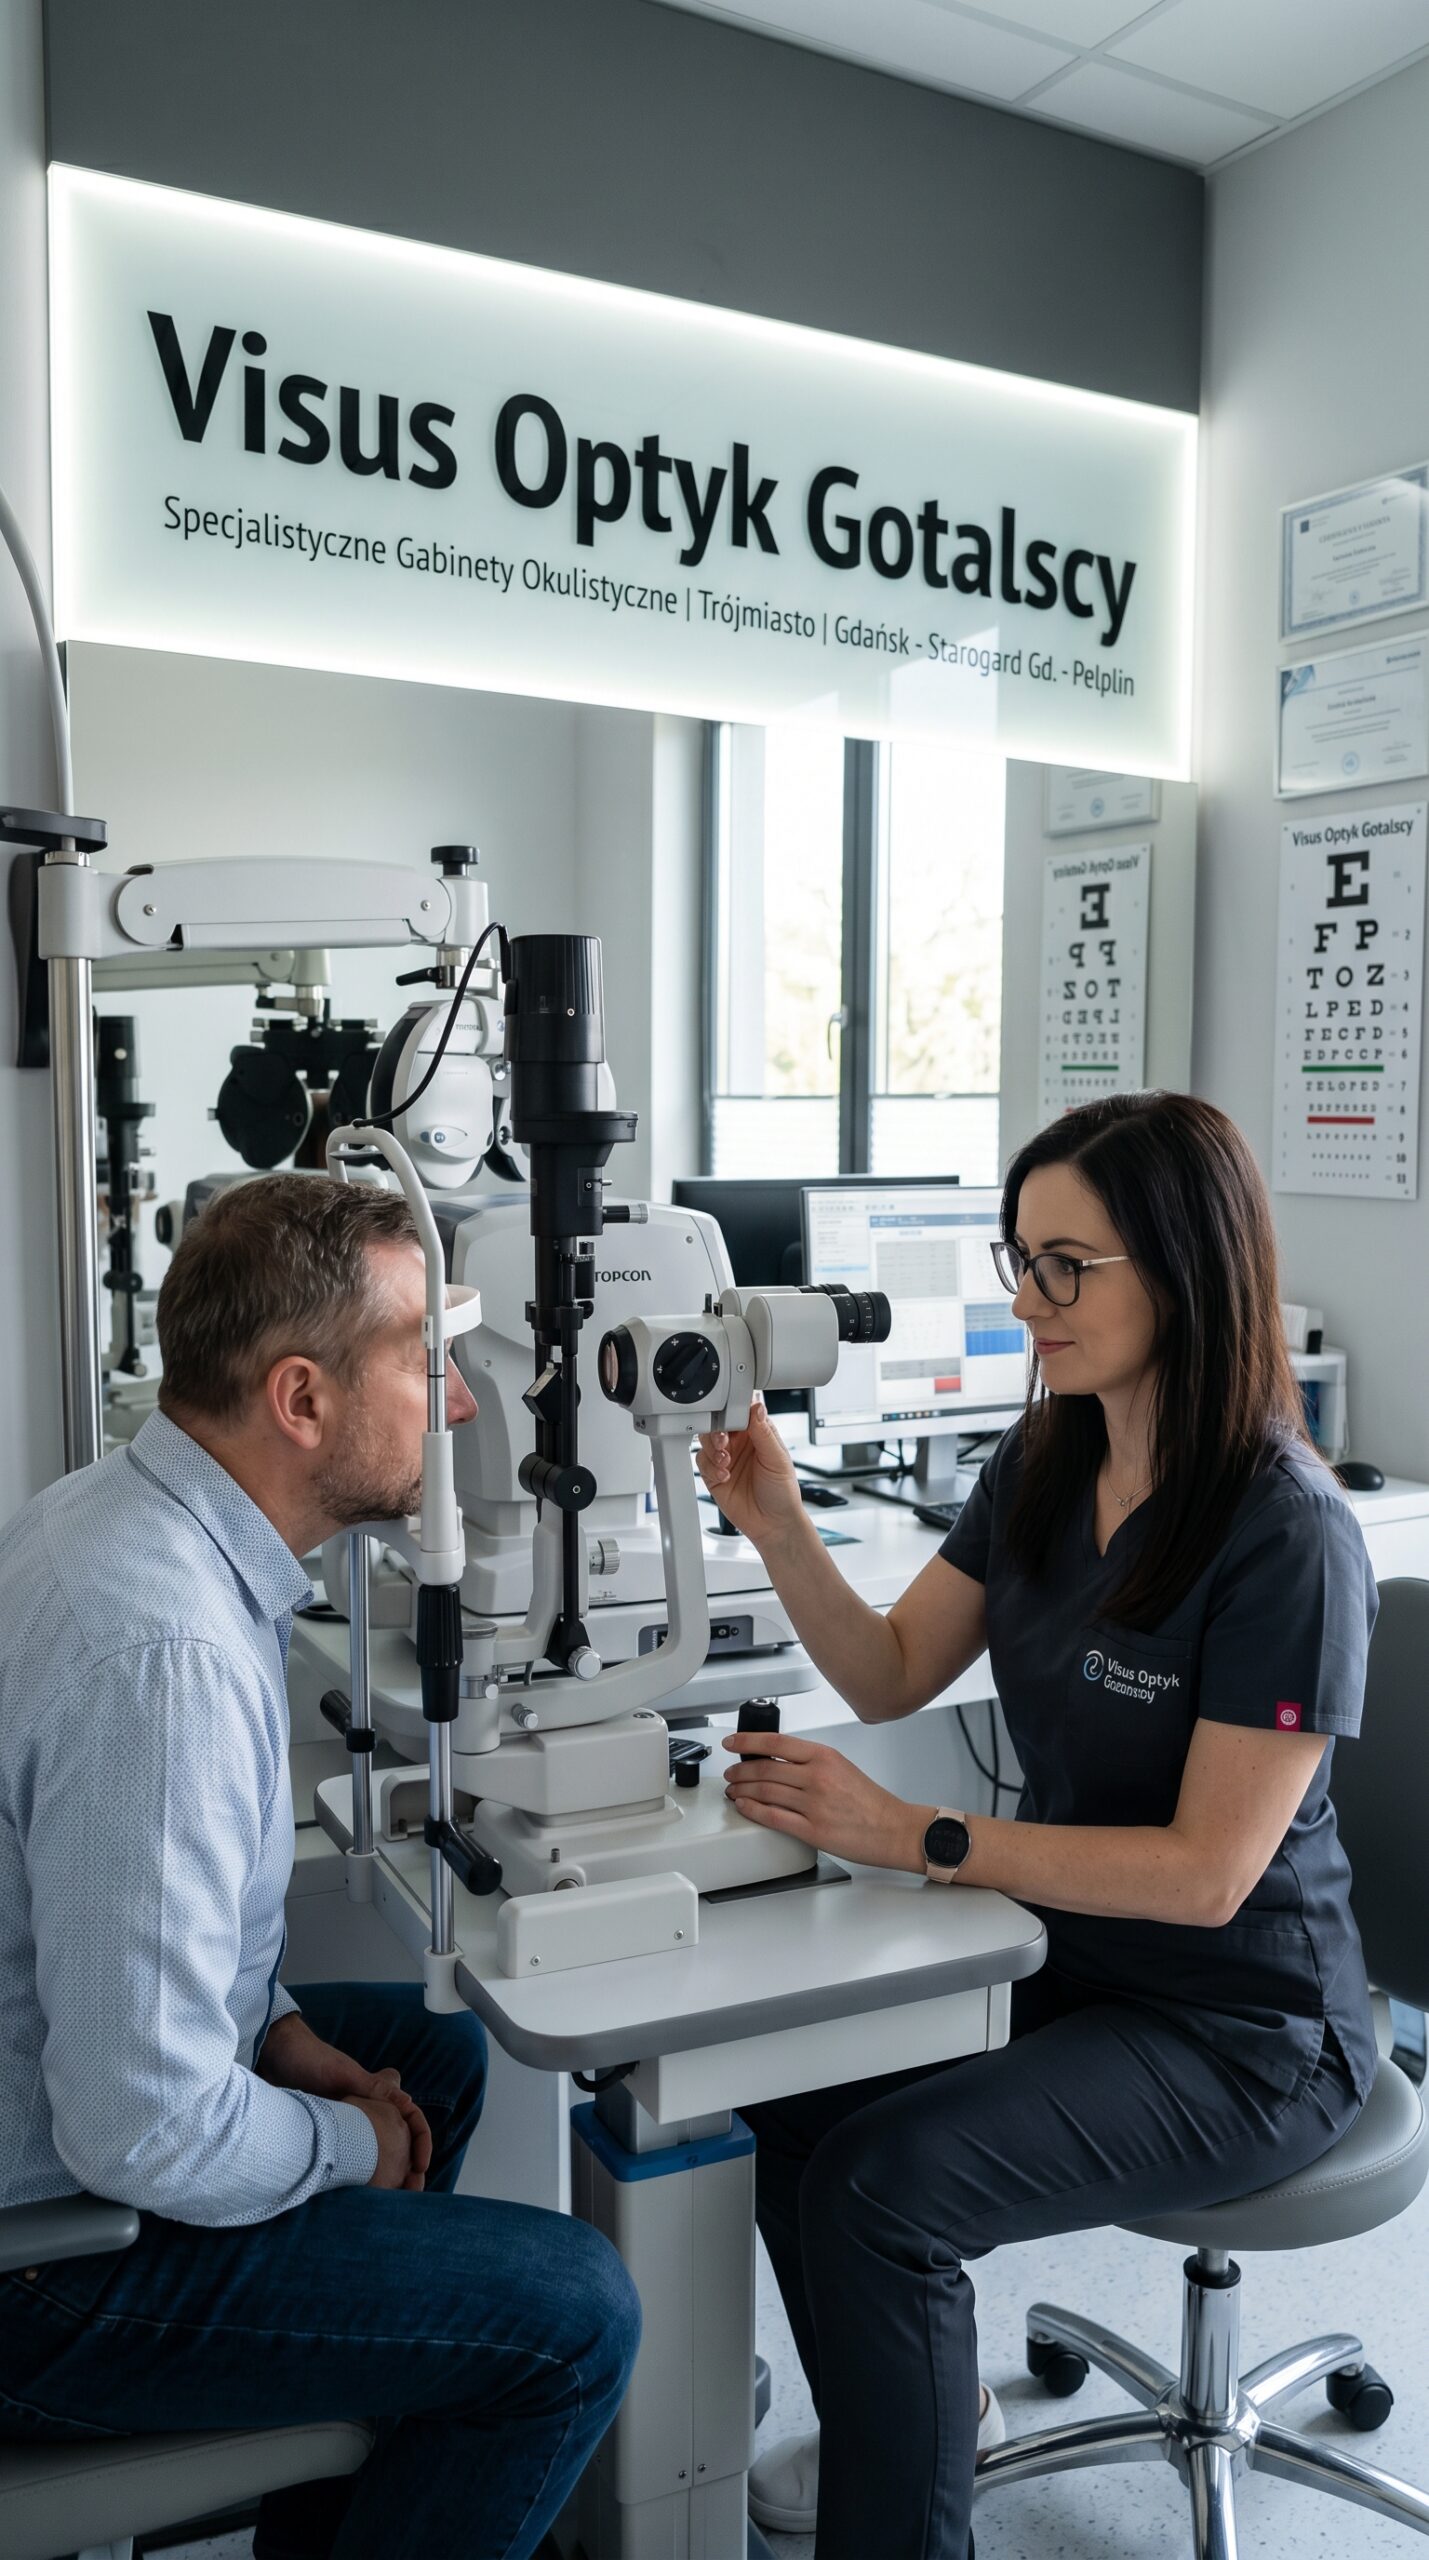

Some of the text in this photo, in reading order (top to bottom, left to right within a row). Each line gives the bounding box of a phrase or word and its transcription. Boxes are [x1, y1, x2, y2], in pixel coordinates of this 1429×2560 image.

[147, 311, 1137, 648] Visus Optyk Gotalscy
[164, 496, 386, 564] Specjalistyczne
[397, 537, 514, 593] Gabinety
[522, 559, 677, 614] Okulistyczne
[697, 589, 815, 638] Trójmiasto
[834, 616, 910, 656] Gdańsk
[927, 632, 1021, 678] Starogard
[1028, 652, 1057, 683] Gd.
[1073, 660, 1135, 698] Pelplin
[1293, 819, 1414, 847] Visus Optyk Gotalscy
[1326, 850, 1370, 909] E
[1314, 922, 1338, 954] F
[1355, 919, 1379, 951] P
[594, 1270, 652, 1283] TOPCON
[1108, 1657, 1180, 1690] Visus Optyk
